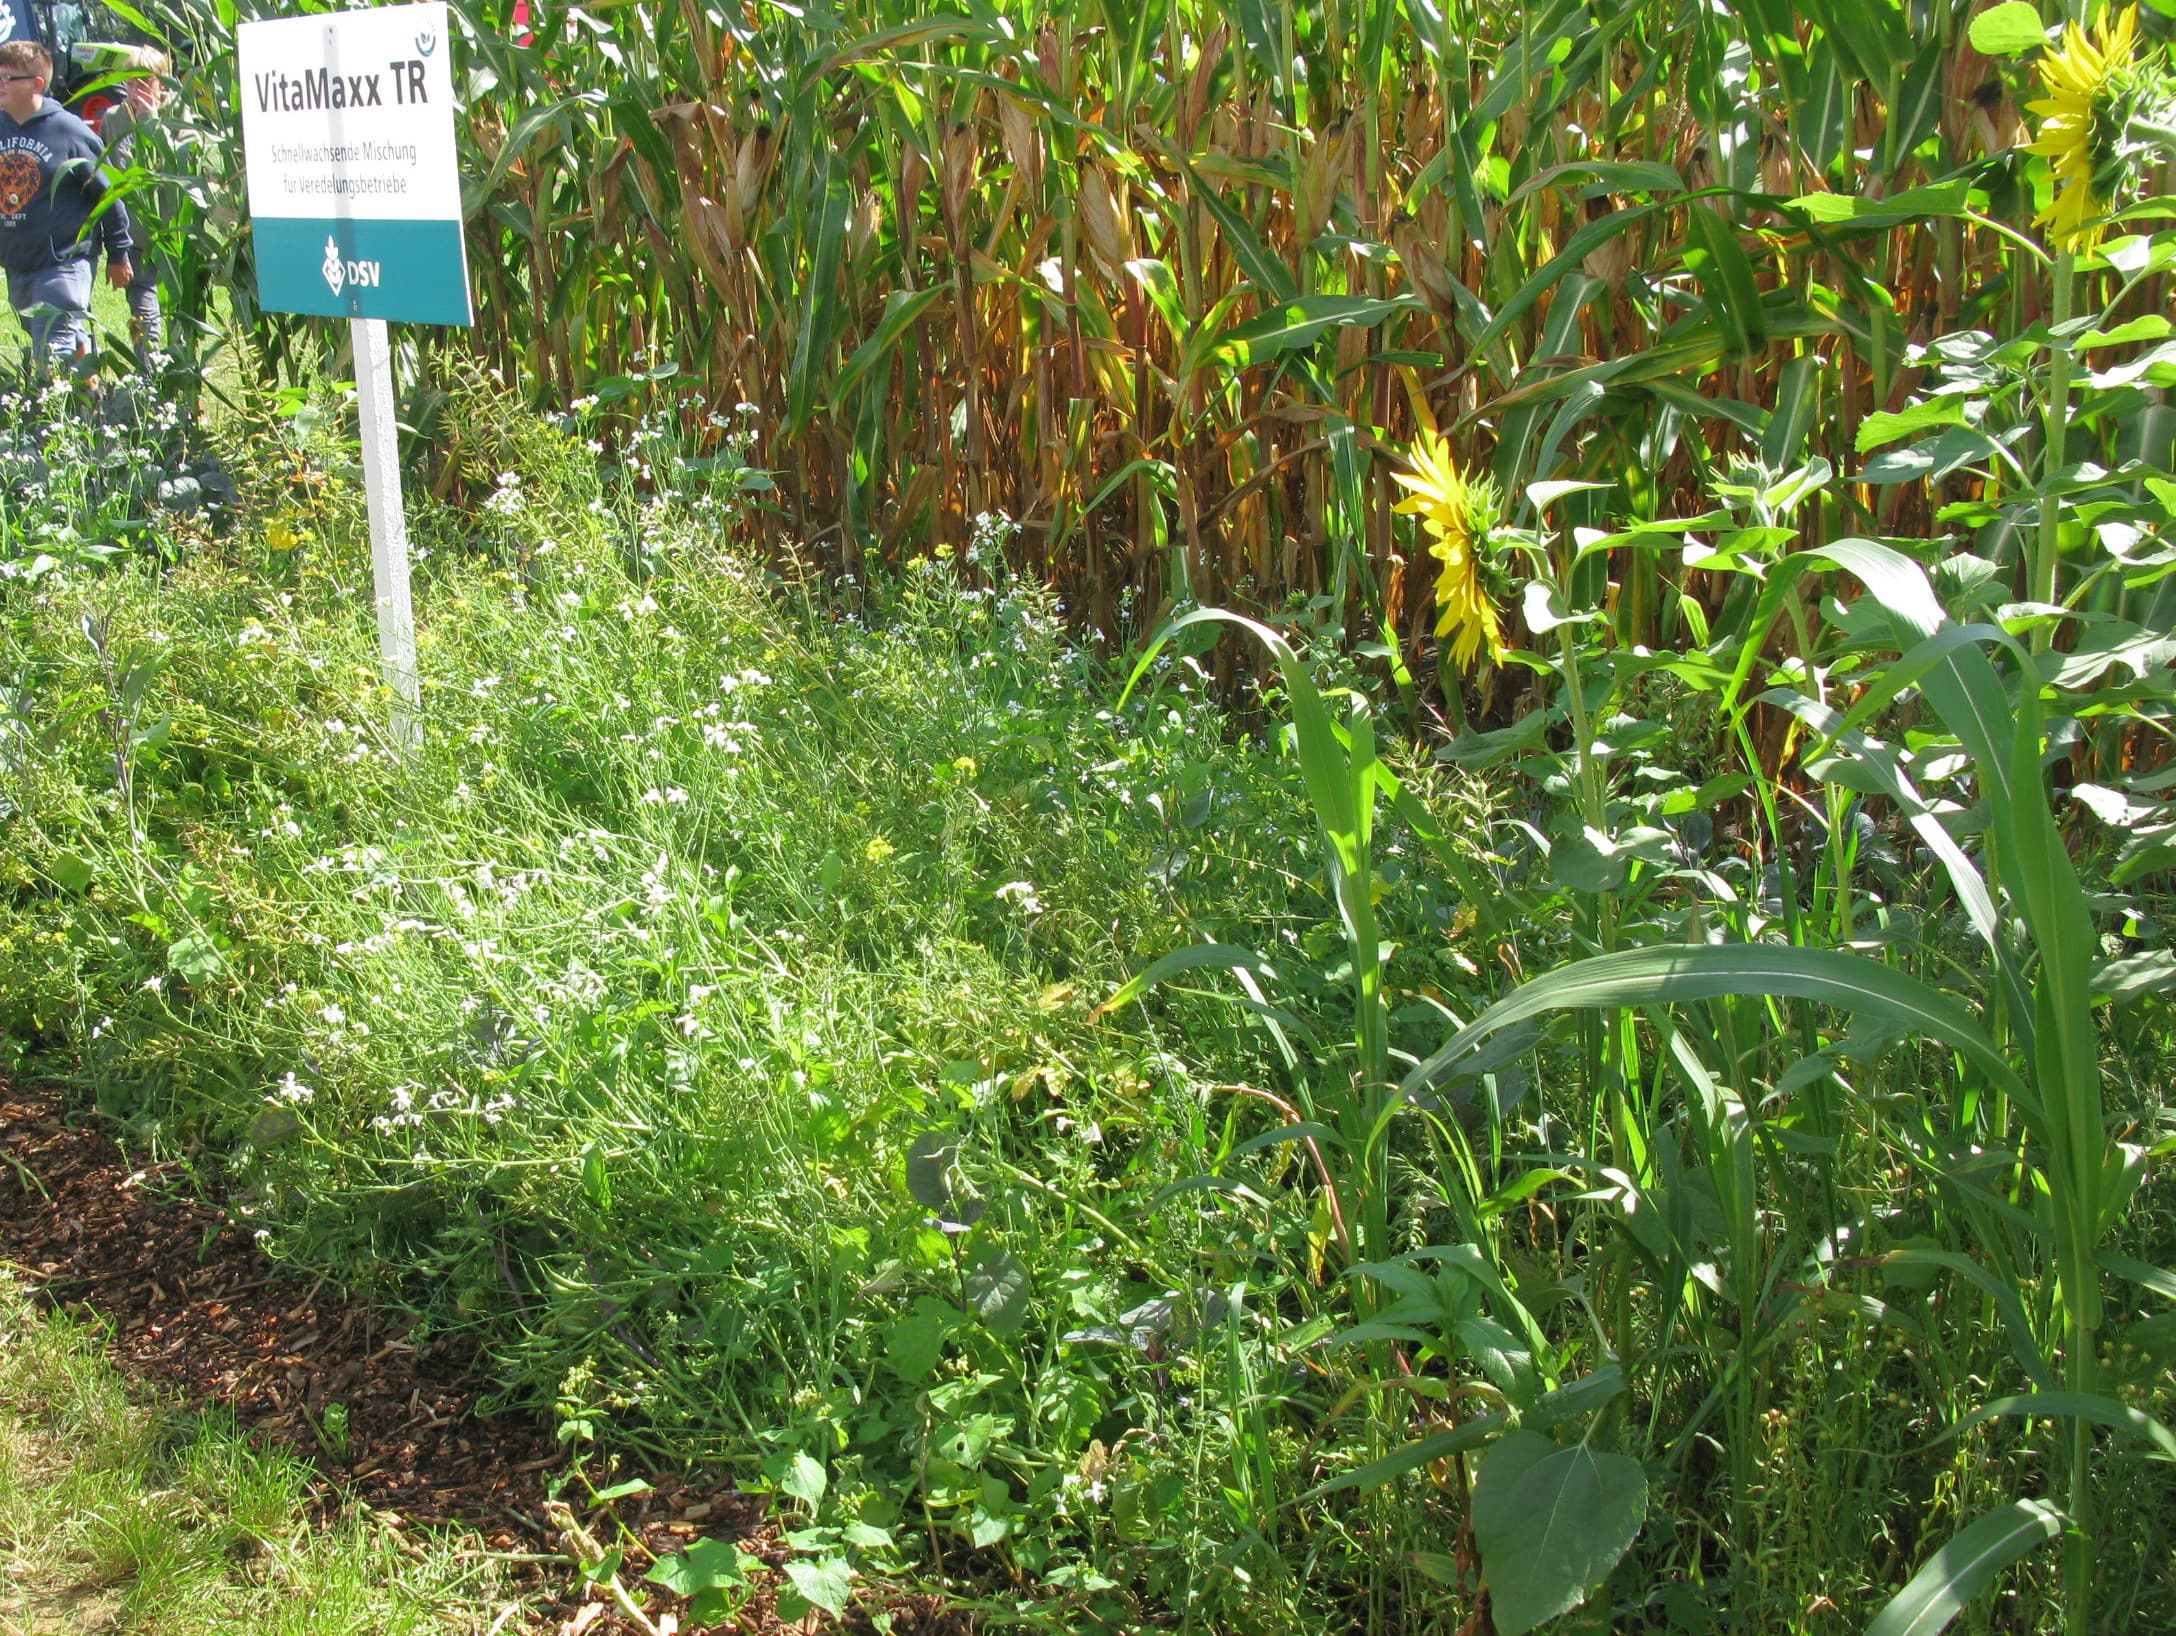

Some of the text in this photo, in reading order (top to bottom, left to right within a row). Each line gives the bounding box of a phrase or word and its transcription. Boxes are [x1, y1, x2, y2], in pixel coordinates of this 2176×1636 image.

[255, 60, 428, 112] VitaMaxx TR
[0, 136, 53, 162] LIFORNIA
[271, 140, 417, 166] Schnellwachsende Mischung
[298, 172, 407, 199] Veredelungsbetriebe
[347, 260, 380, 287] DSV
